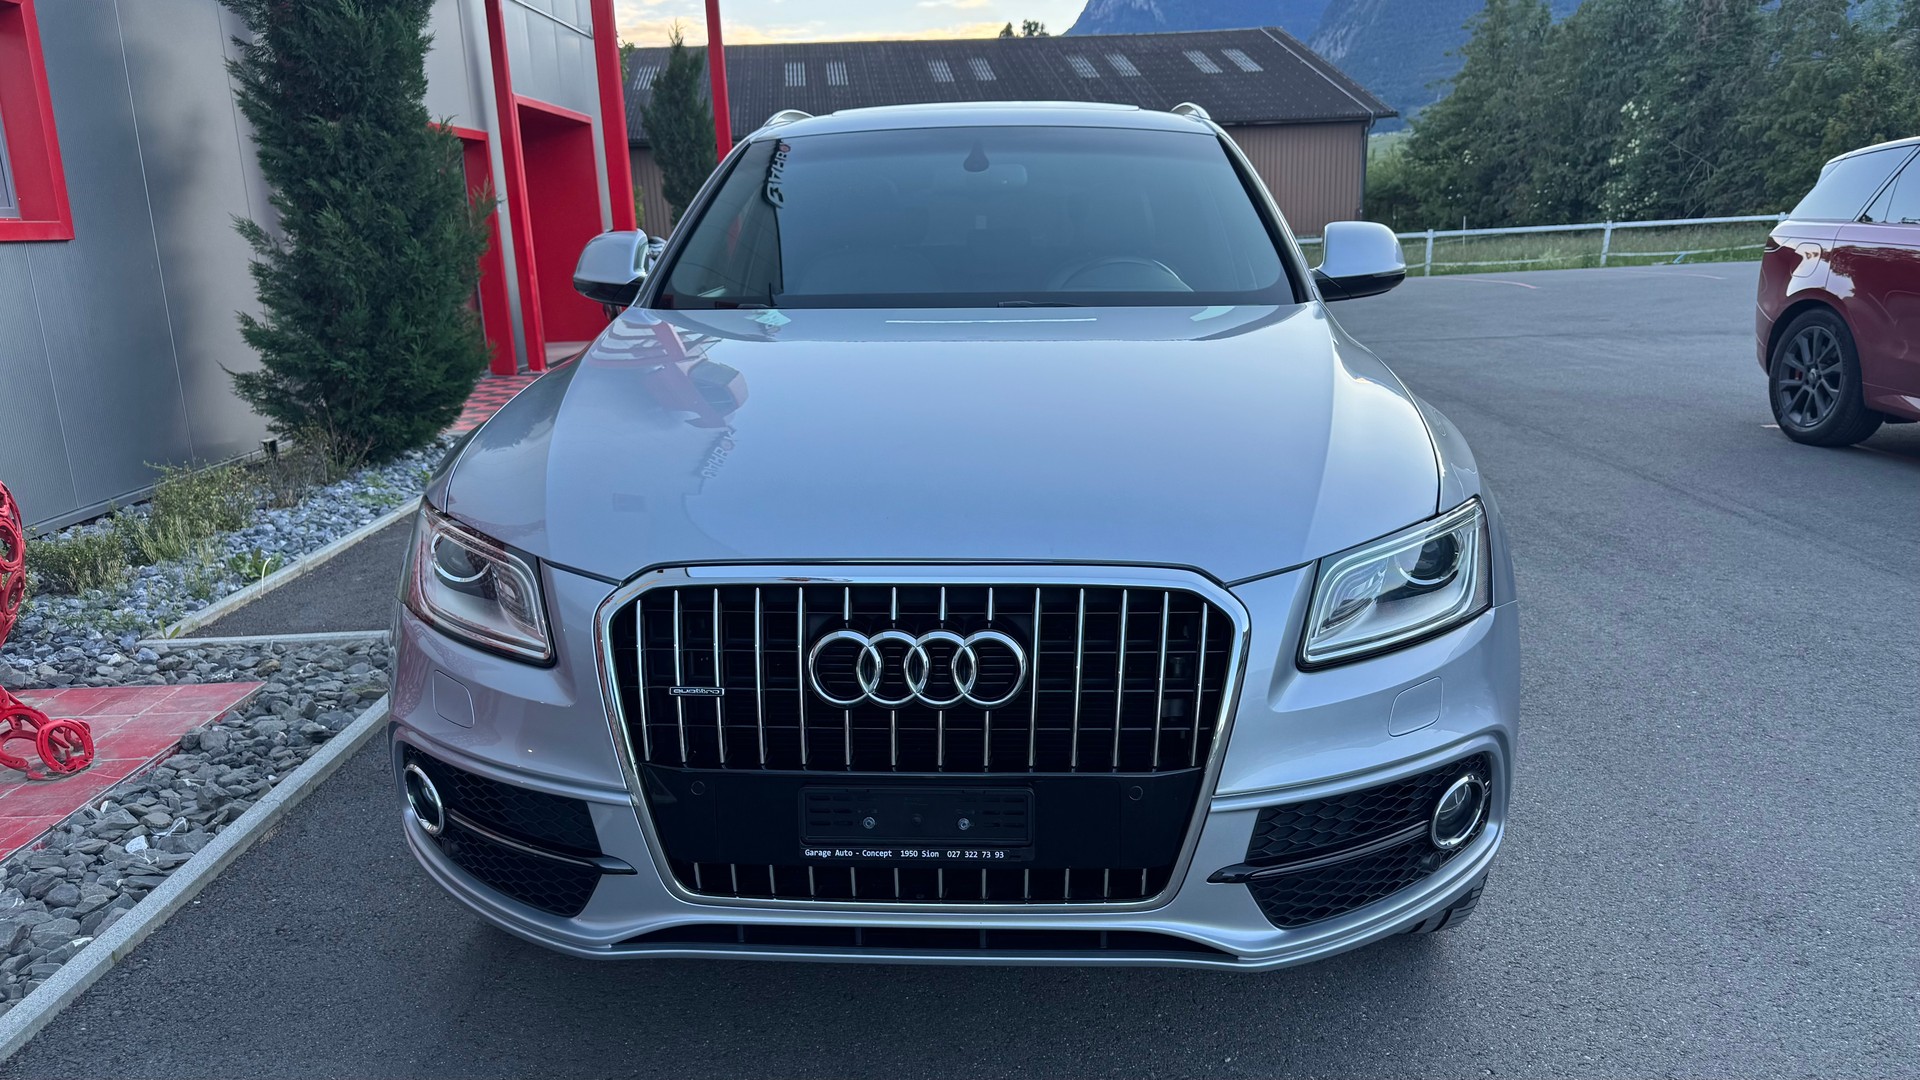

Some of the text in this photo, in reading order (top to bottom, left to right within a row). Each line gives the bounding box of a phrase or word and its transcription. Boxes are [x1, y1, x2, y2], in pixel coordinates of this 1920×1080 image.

[804, 848, 832, 858] Garage
[834, 849, 853, 857] Auto
[862, 849, 893, 858] Concept
[921, 850, 940, 858] Sion
[947, 850, 961, 858] 027
